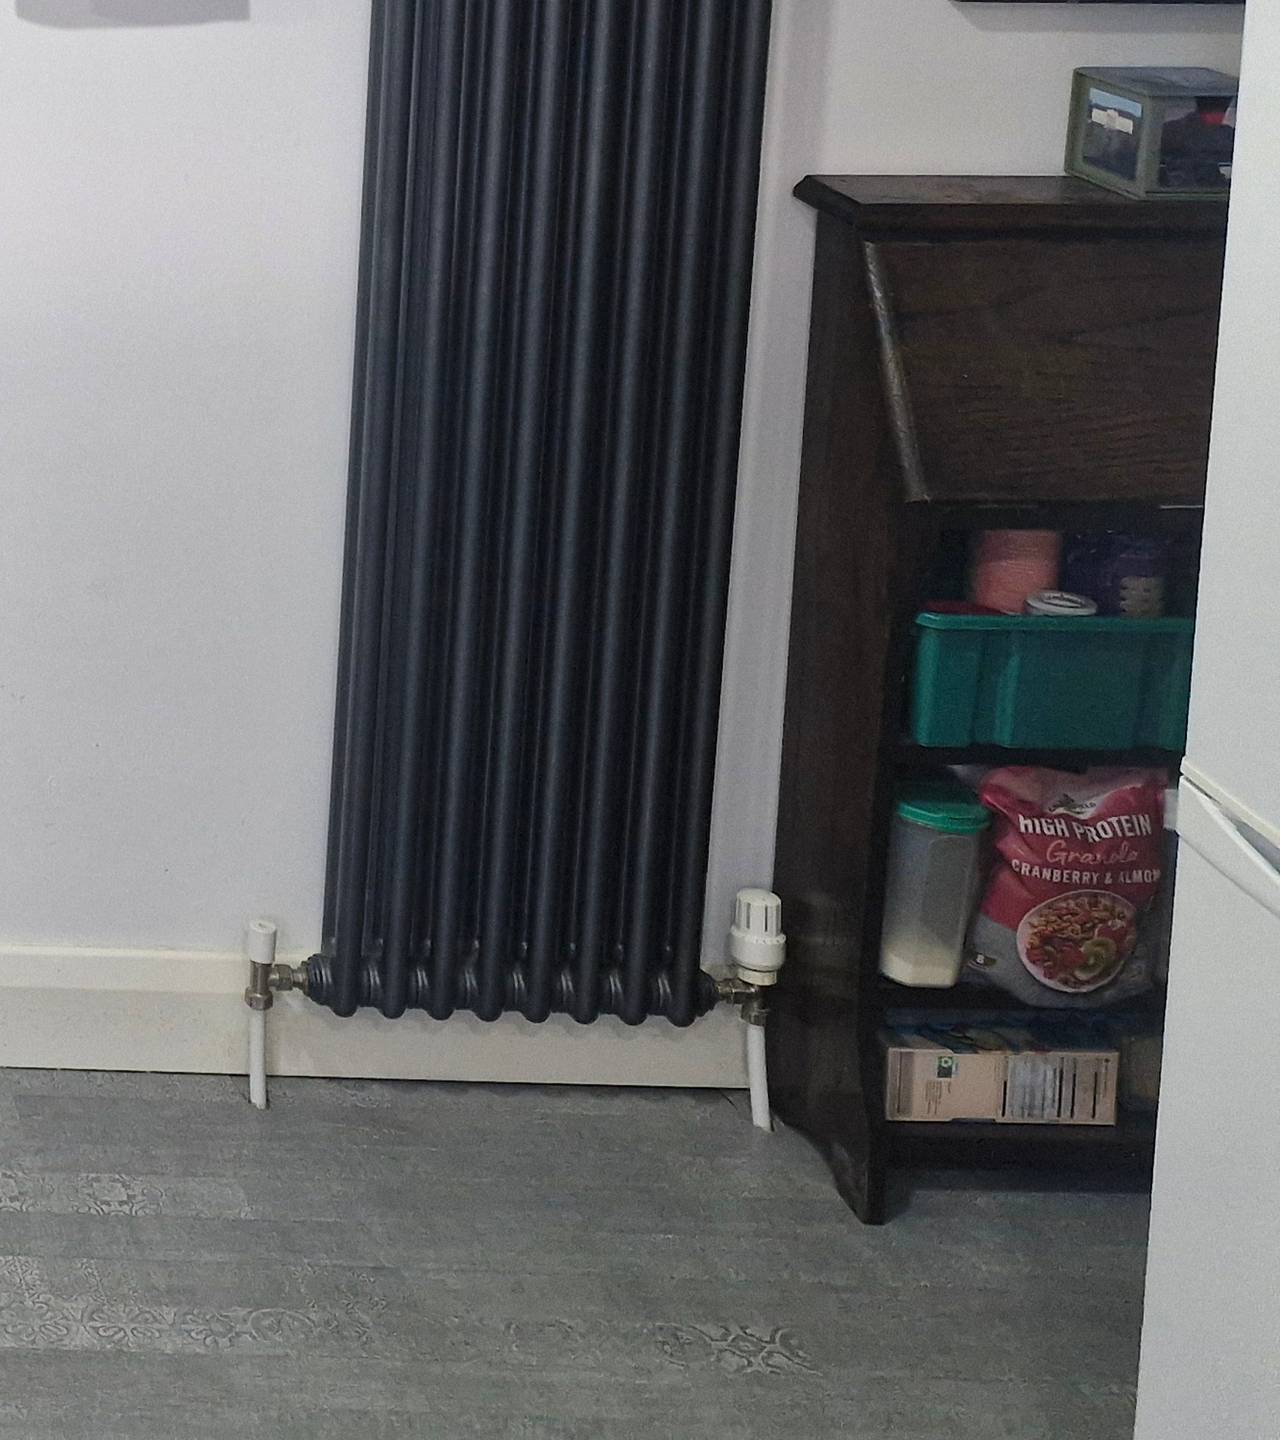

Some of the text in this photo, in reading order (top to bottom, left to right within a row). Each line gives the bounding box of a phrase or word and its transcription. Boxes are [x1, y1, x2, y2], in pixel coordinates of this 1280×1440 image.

[1018, 813, 1153, 843] HIGH PROTEIN
[1046, 839, 1138, 866] Granola
[1011, 858, 1100, 885] CRANBERRY
[1104, 874, 1113, 885] &
